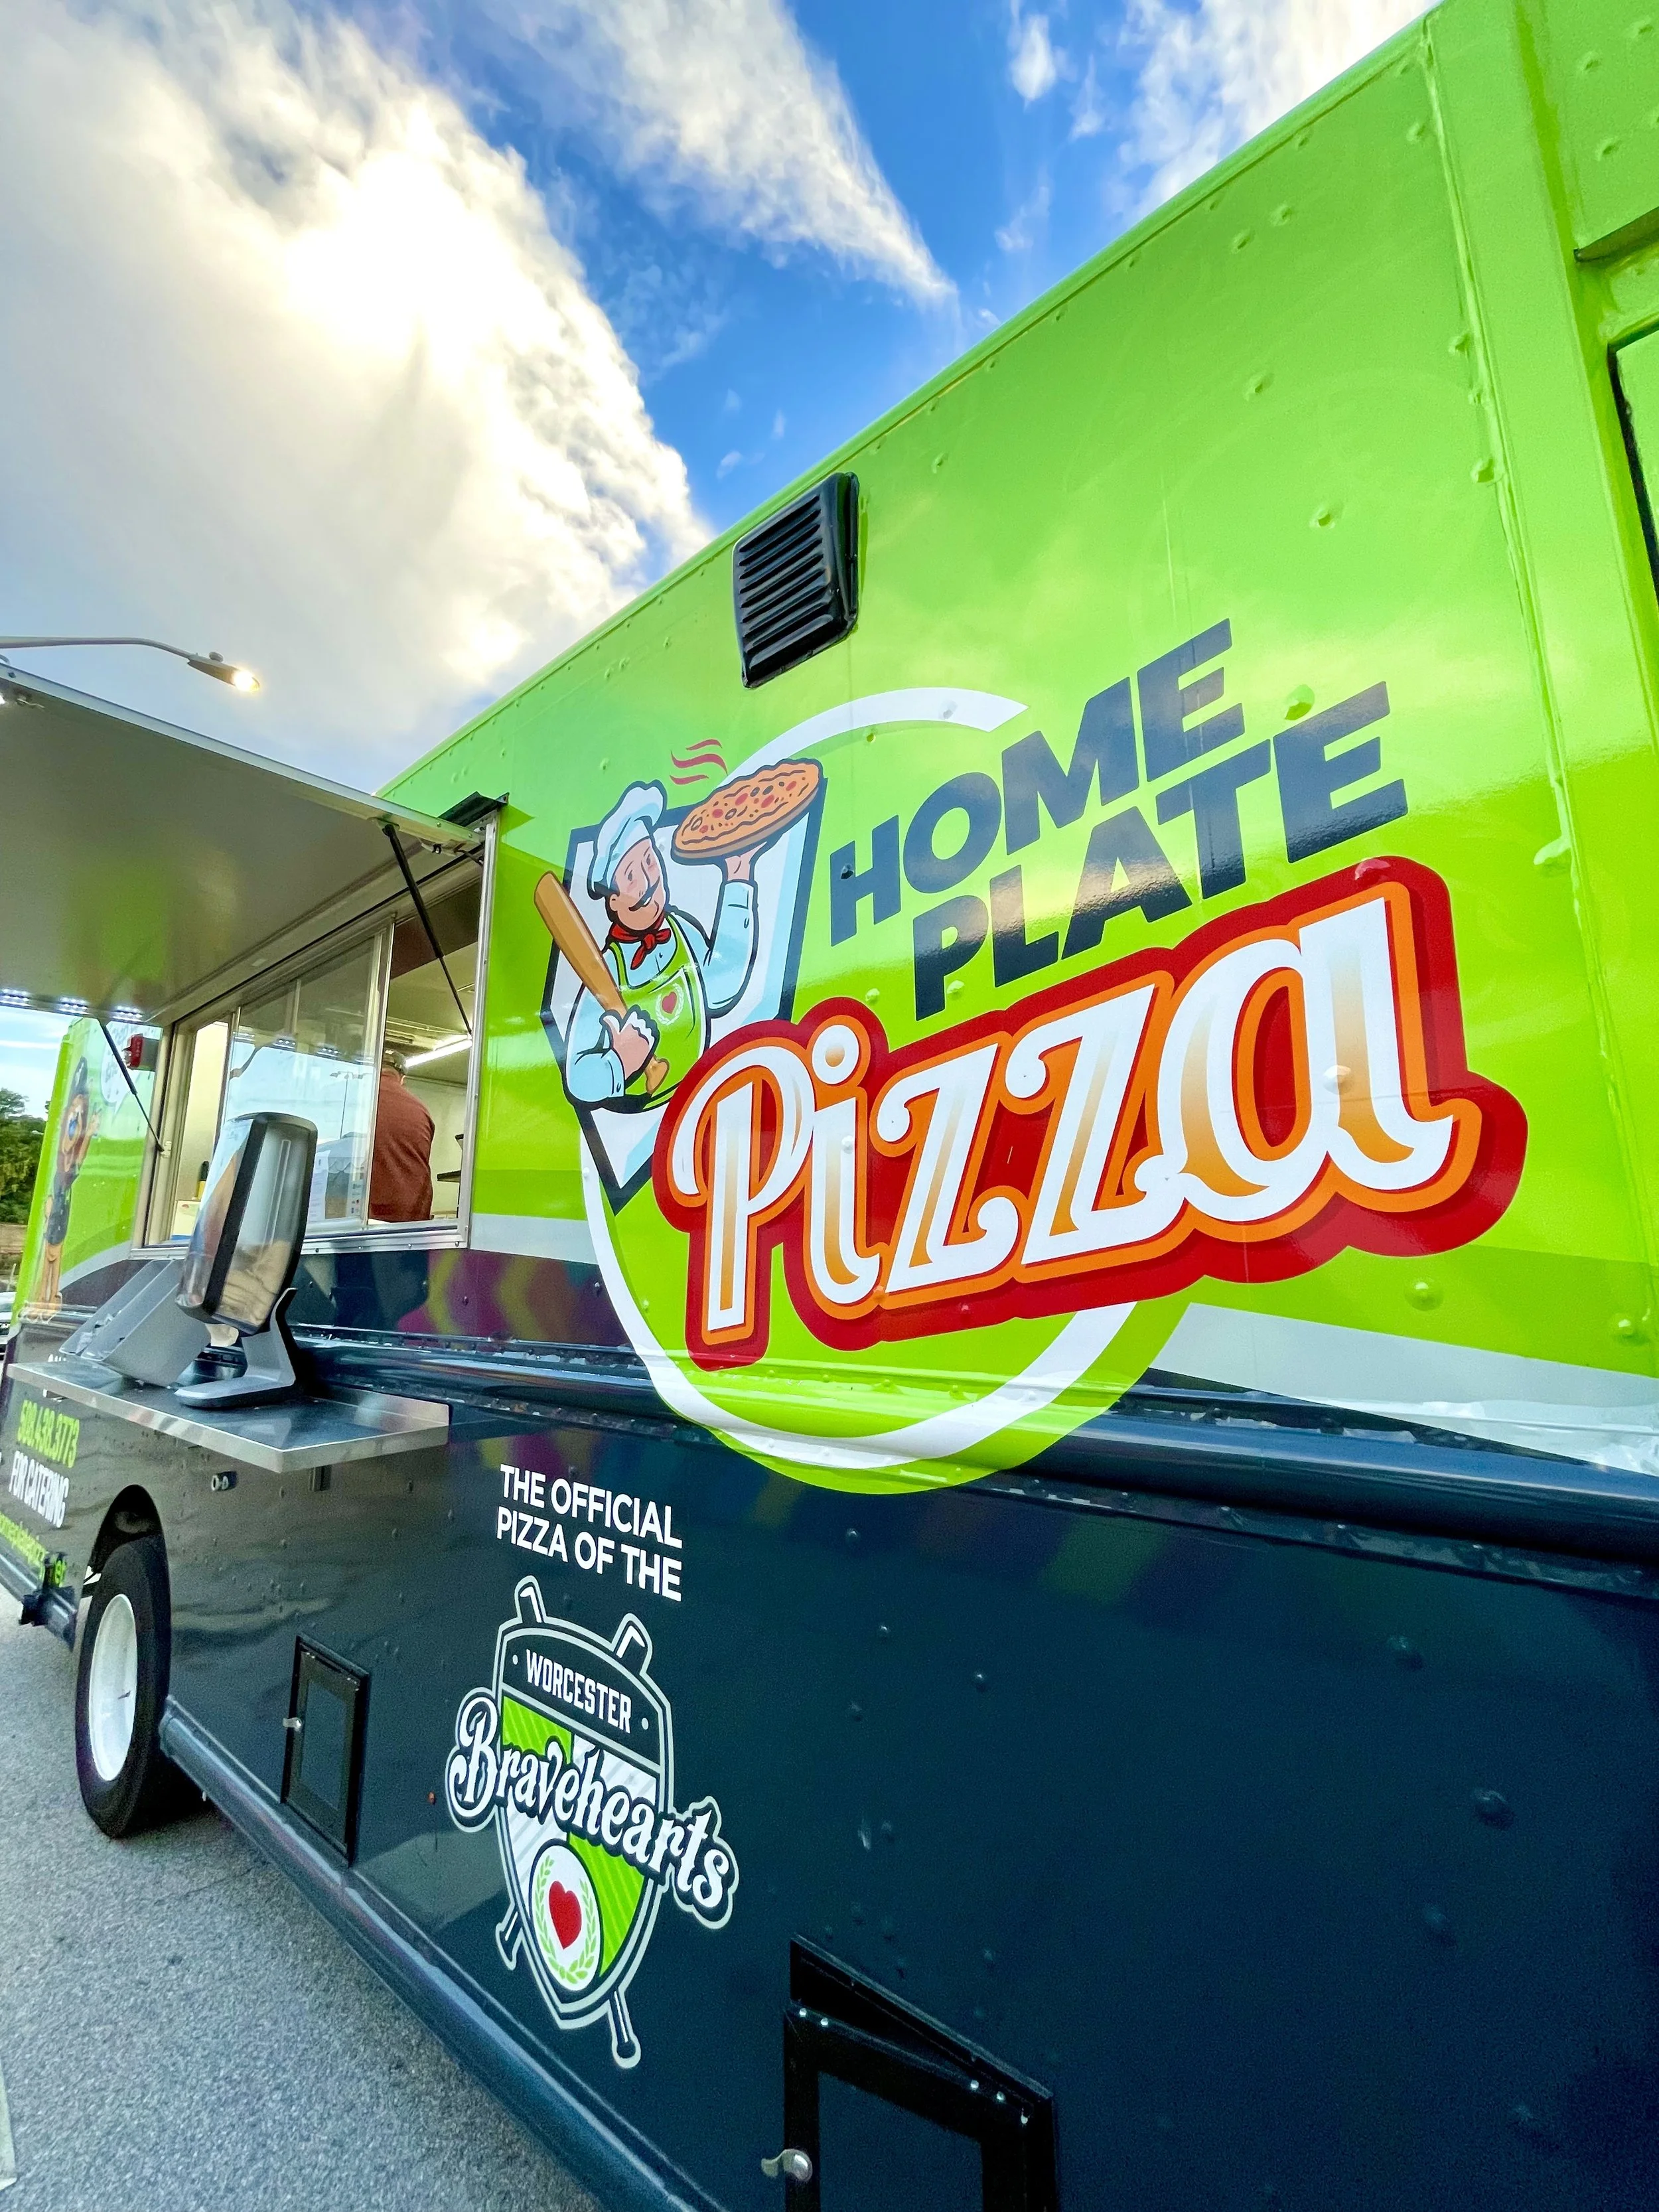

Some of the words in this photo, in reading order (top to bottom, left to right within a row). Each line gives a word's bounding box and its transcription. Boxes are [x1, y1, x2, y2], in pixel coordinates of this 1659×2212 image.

[830, 617, 1245, 946] HOME
[912, 681, 1409, 1021] PLATE
[669, 896, 1455, 1333] Pizza
[8, 1450, 29, 1501] FOR
[24, 1458, 70, 1528] CATERING
[496, 1506, 568, 1563] PIZZA
[574, 1531, 615, 1575] OF
[620, 1543, 682, 1602] THE
[500, 1463, 546, 1509] THE
[551, 1478, 683, 1549] OFFICIAL
[526, 1649, 632, 1734] WORCESTER
[448, 1696, 730, 1910] Bravehearts
